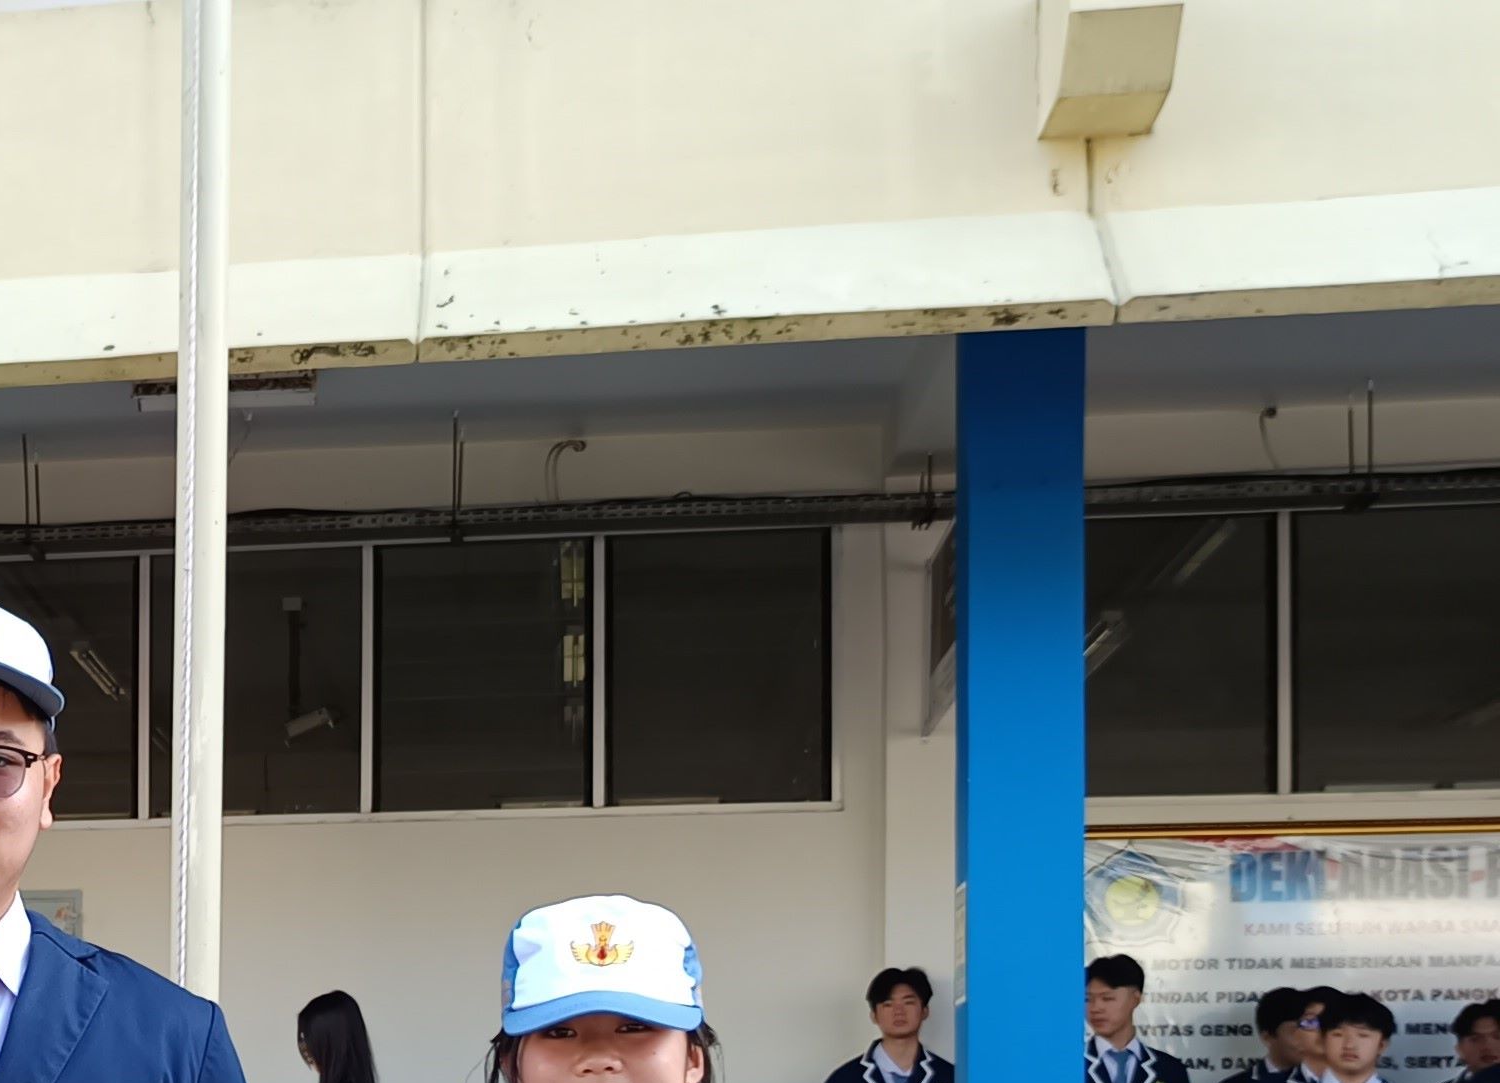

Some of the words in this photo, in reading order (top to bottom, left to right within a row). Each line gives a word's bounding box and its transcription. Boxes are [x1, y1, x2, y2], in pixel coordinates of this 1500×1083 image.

[1244, 922, 1290, 936] KAMI
[1151, 958, 1219, 970] MOTOR
[1226, 957, 1283, 970] TIDAK
[1290, 955, 1422, 970] MEMBERIKAN
[1200, 1023, 1254, 1036] GENG
